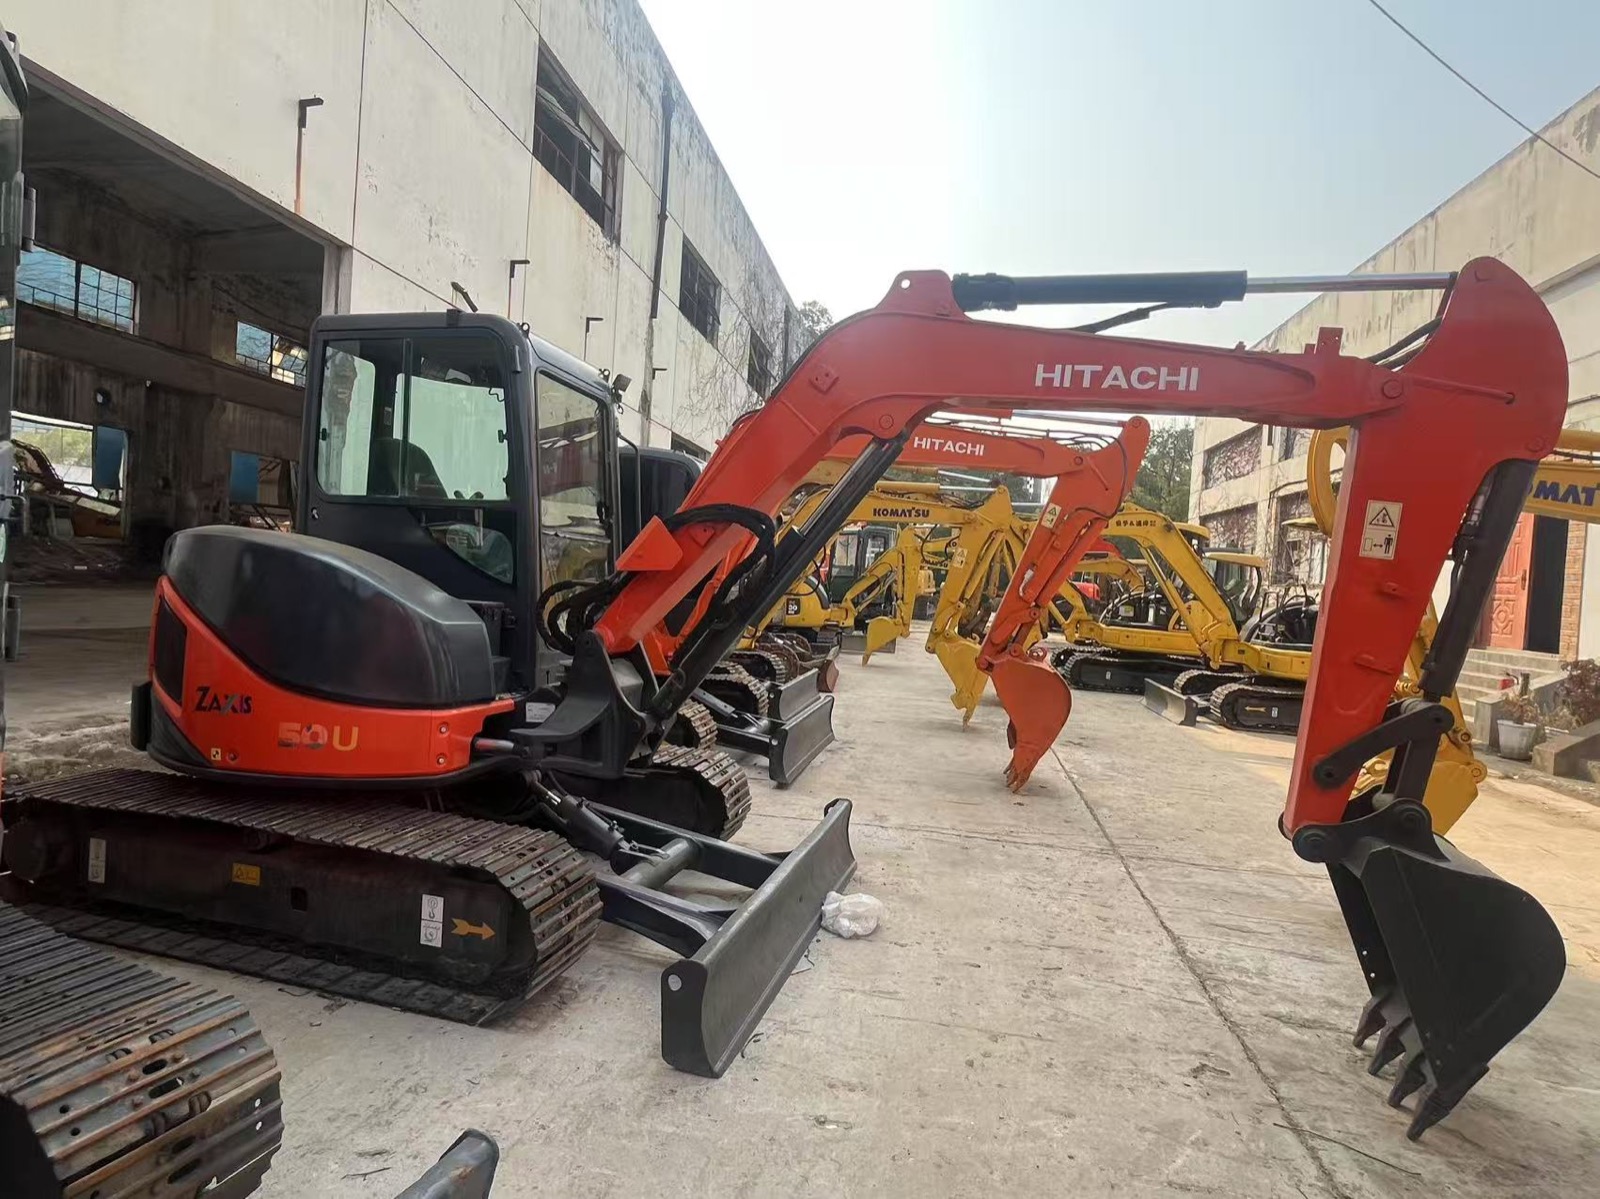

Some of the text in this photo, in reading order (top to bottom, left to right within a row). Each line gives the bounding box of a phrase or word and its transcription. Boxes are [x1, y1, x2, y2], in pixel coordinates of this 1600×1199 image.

[1034, 363, 1200, 392] HITACHI
[913, 436, 985, 457] HITACHI
[872, 506, 930, 518] KOMATSU
